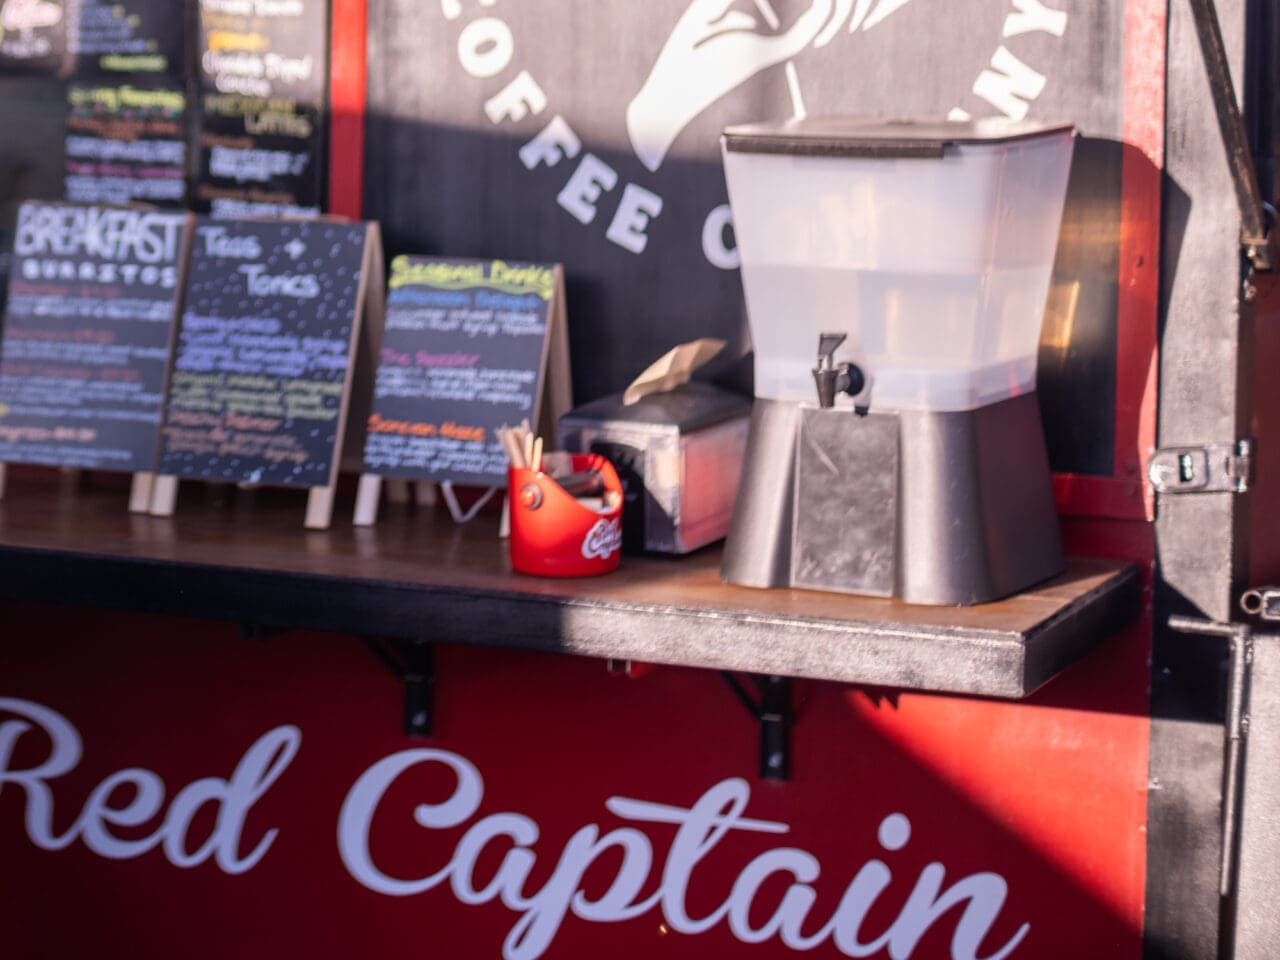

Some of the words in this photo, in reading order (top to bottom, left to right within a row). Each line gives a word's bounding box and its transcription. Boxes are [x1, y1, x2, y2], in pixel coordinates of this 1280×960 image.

[15, 202, 188, 263] BREAKFAST
[196, 225, 263, 260] Teas
[22, 257, 179, 289] BURRITOS
[336, 746, 1031, 960] Captain
